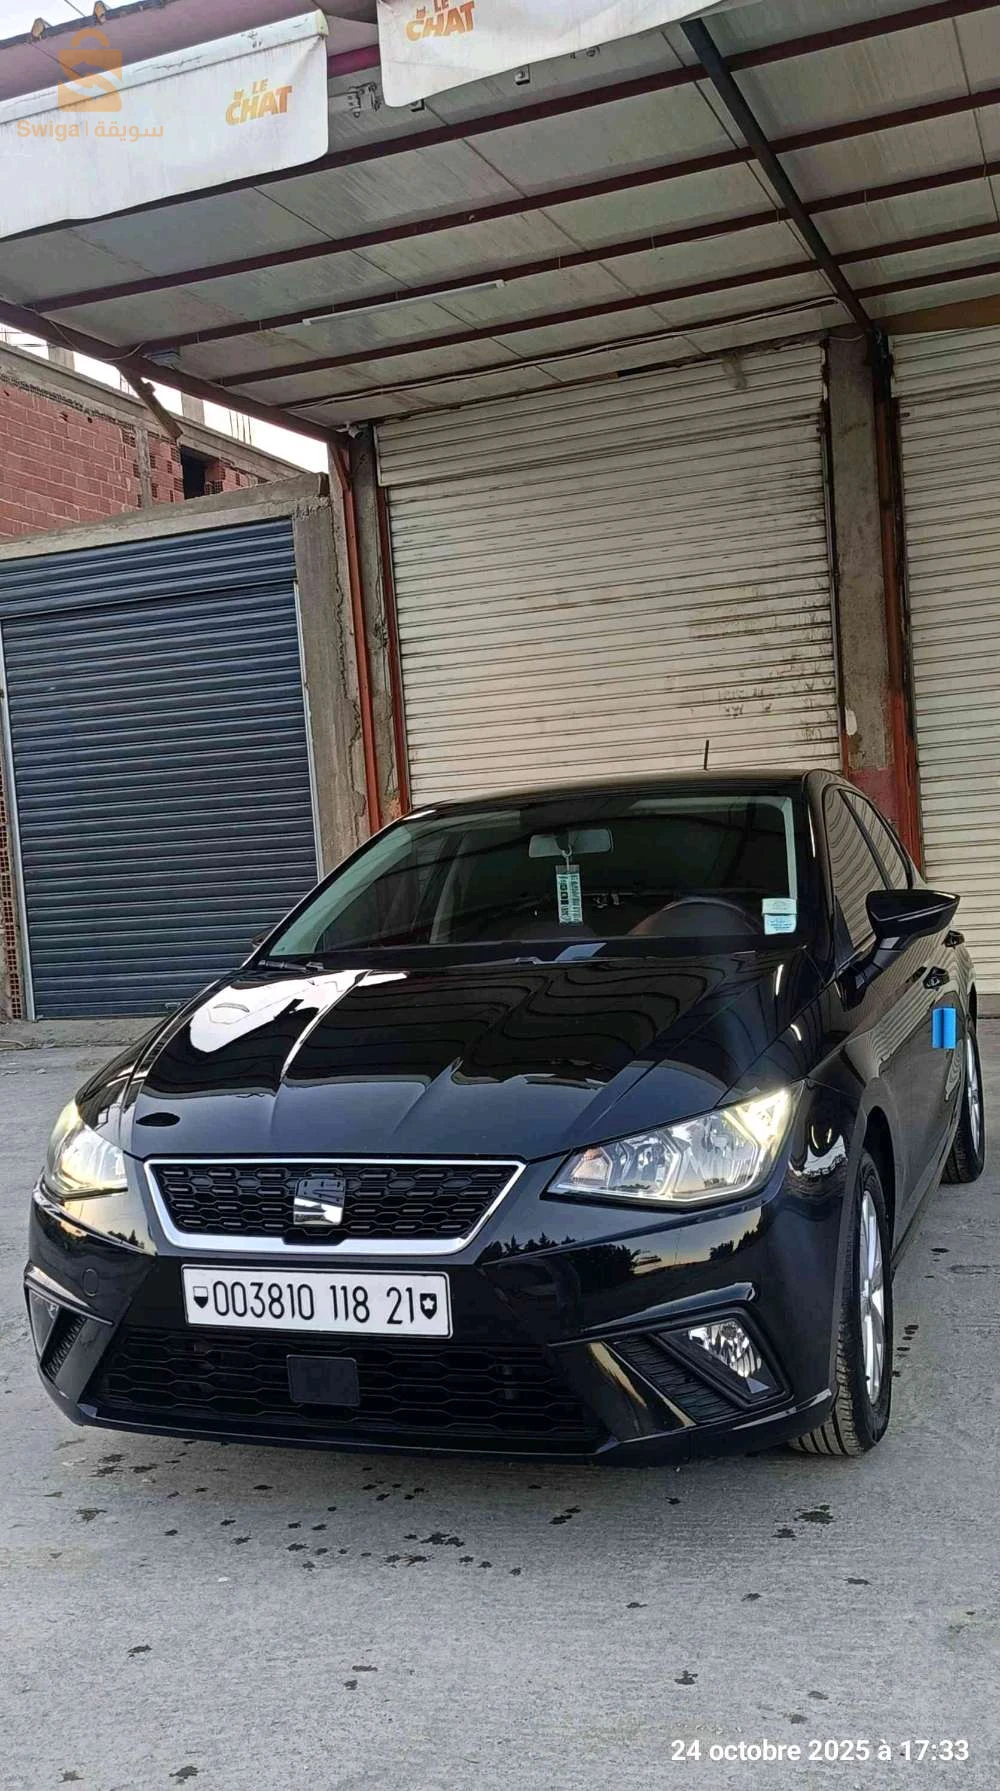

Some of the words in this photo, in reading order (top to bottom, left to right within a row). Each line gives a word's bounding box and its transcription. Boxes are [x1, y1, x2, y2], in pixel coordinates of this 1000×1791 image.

[406, 1, 475, 41] CHAT
[433, 0, 449, 13] LE
[225, 85, 293, 126] CHAT
[252, 79, 268, 94] LE
[213, 1280, 315, 1321] 003810
[330, 1285, 370, 1323] 118
[386, 1286, 415, 1324] 21
